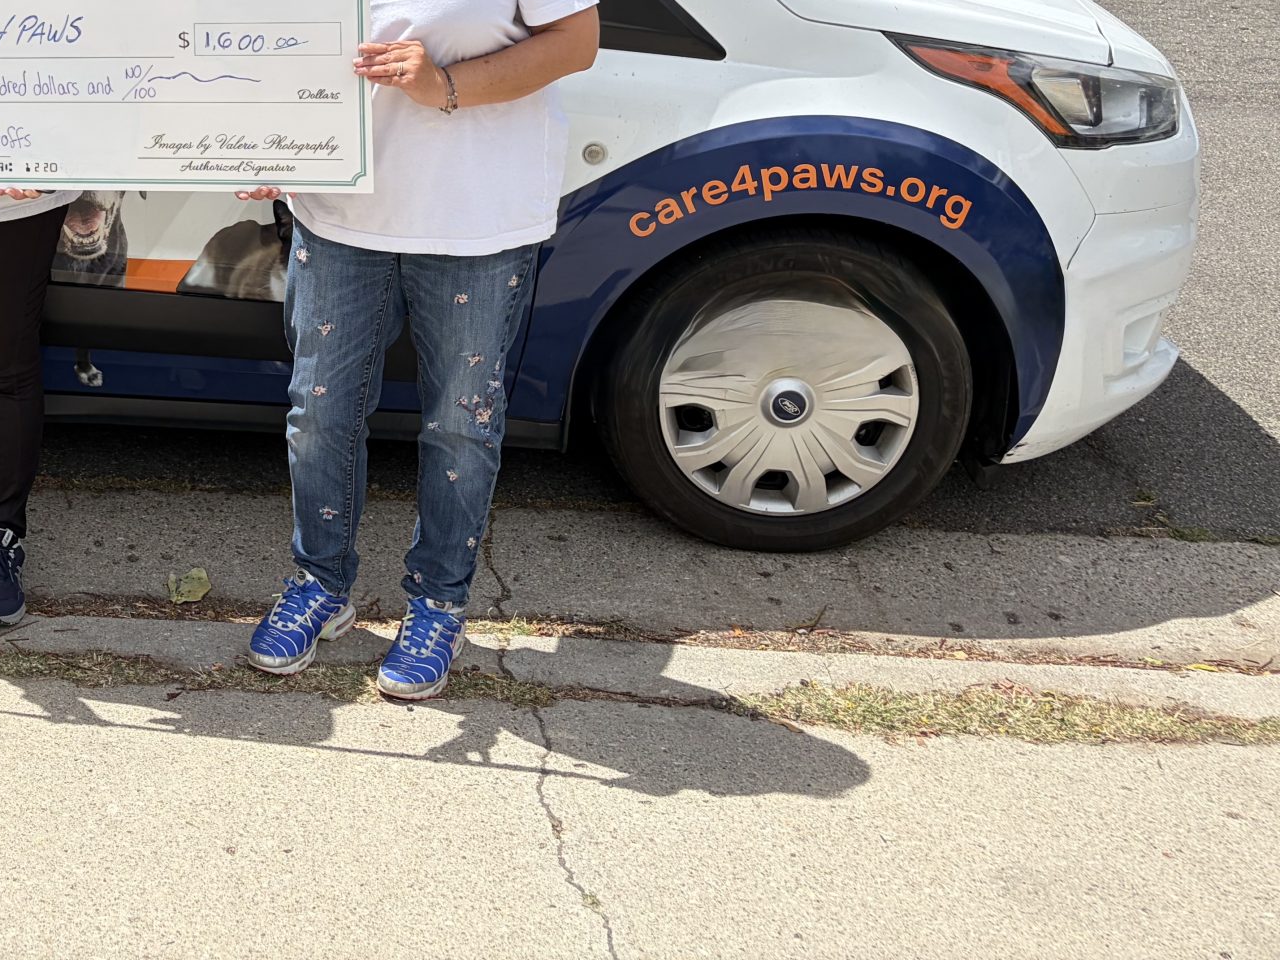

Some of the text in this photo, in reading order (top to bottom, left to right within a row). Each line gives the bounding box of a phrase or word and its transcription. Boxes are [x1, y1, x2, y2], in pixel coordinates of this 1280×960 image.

[15, 14, 85, 46] PAWS
[178, 31, 190, 50] $
[33, 71, 80, 96] dollars
[87, 76, 114, 96] and
[297, 88, 341, 100] Dollars
[144, 133, 340, 156] Images by Valerie Photography
[25, 162, 58, 173] 1220
[179, 160, 297, 176] Authorized Signature
[628, 162, 973, 238] care4paws.org
